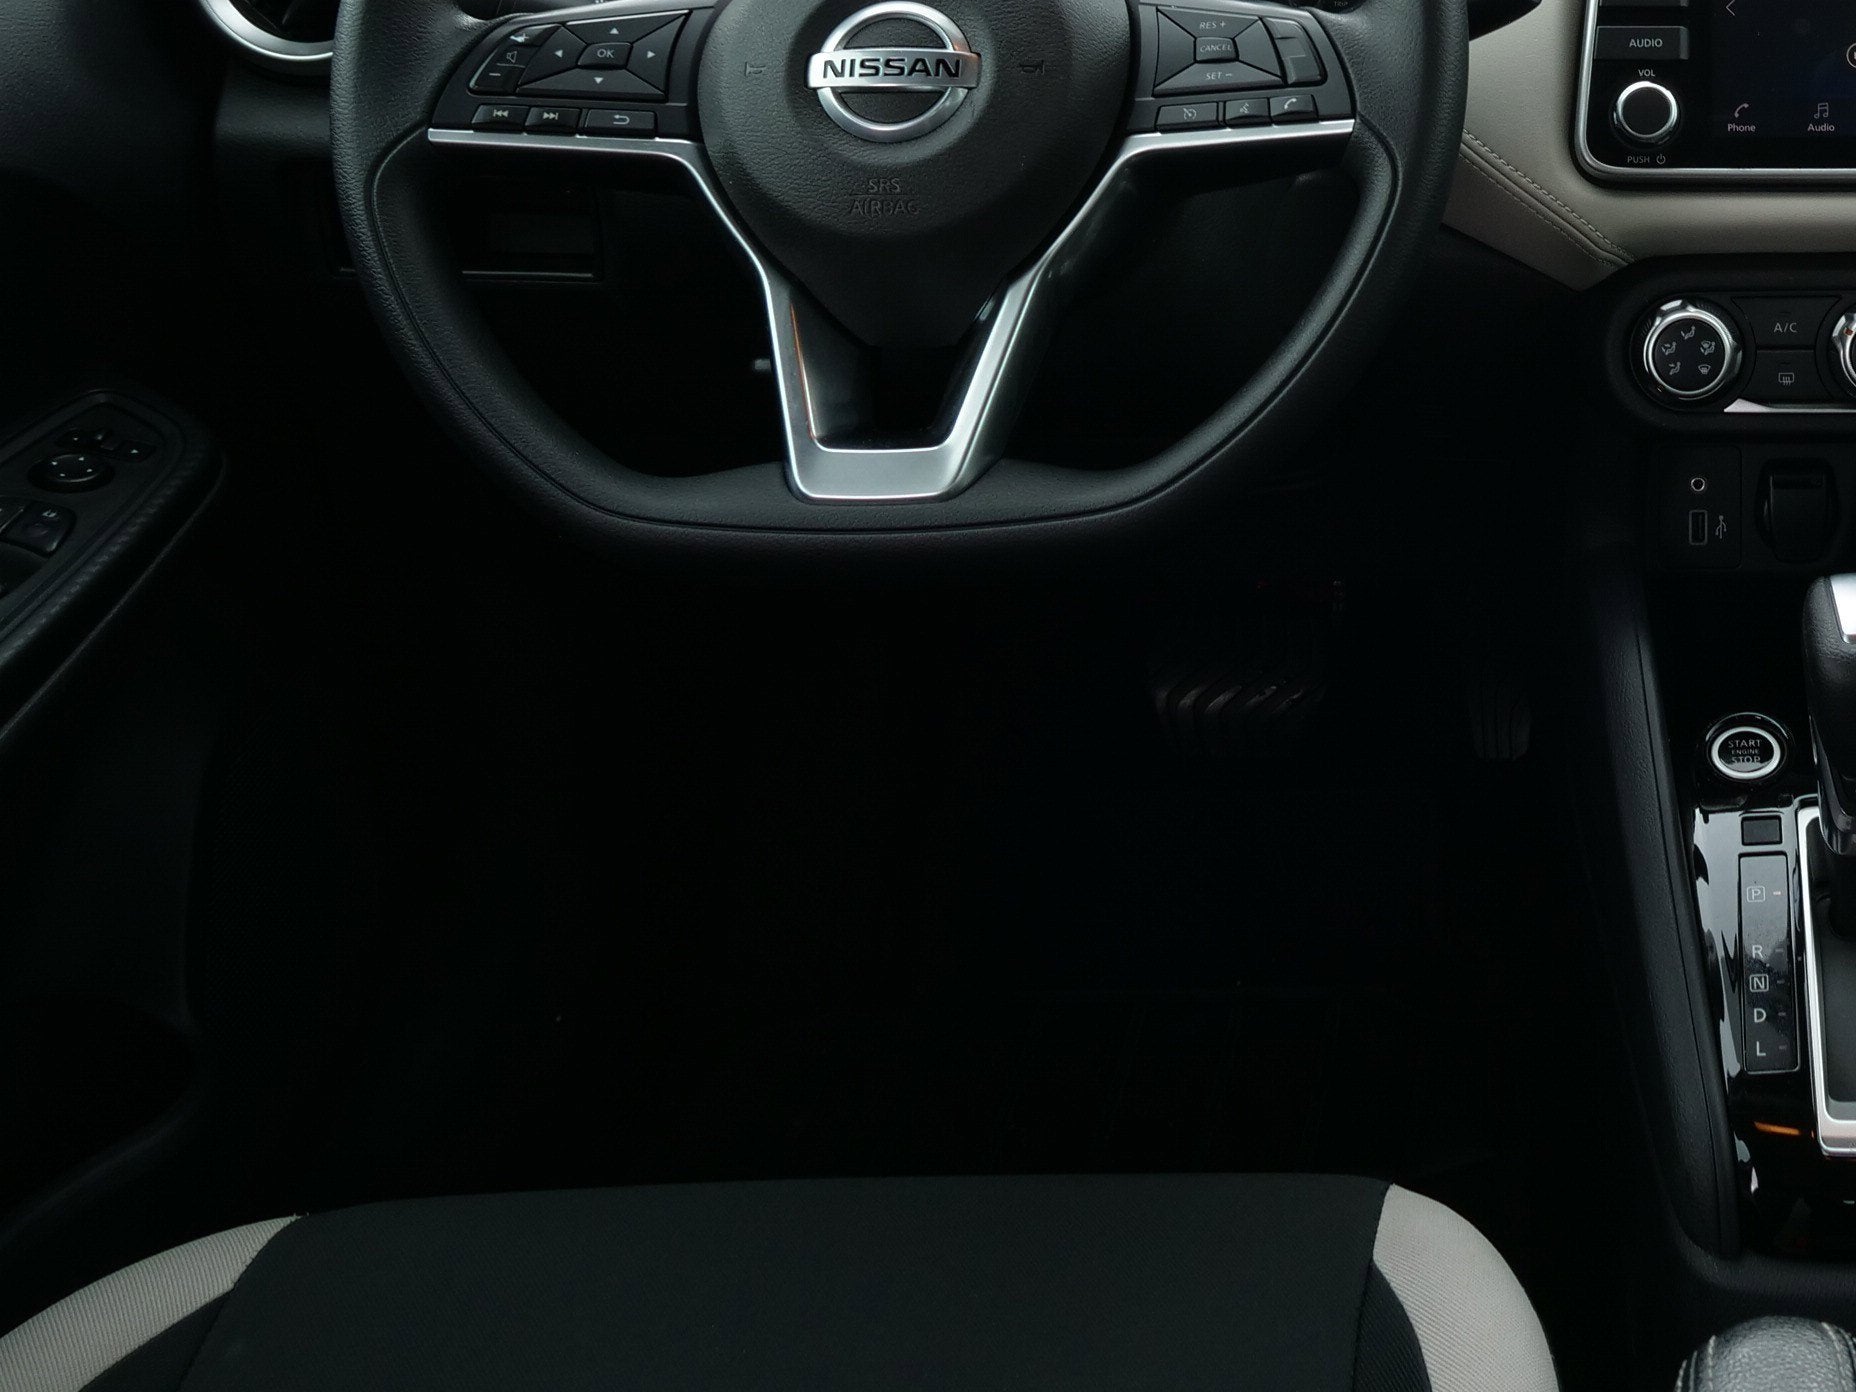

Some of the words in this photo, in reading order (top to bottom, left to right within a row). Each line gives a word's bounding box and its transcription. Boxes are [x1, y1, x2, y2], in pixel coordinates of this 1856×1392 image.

[1199, 21, 1218, 30] RES
[1199, 42, 1233, 53] CANCEL
[1628, 38, 1664, 48] AUDIO
[596, 48, 615, 59] OK
[822, 57, 963, 79] NISSAN
[1638, 68, 1657, 77] VOL
[1205, 71, 1223, 80] SET
[1727, 122, 1757, 133] Phone
[1807, 122, 1836, 133] Audio
[1626, 154, 1650, 164] PUSH
[867, 177, 902, 193] SRS
[1773, 322, 1799, 334] A/C
[1727, 738, 1762, 749] START
[1731, 748, 1761, 756] ENGINE
[1731, 755, 1762, 764] STOP
[1751, 888, 1762, 900] P
[1752, 944, 1764, 959] R
[1753, 976, 1766, 991] N
[1753, 1008, 1767, 1024] D
[1756, 1040, 1767, 1057] L
